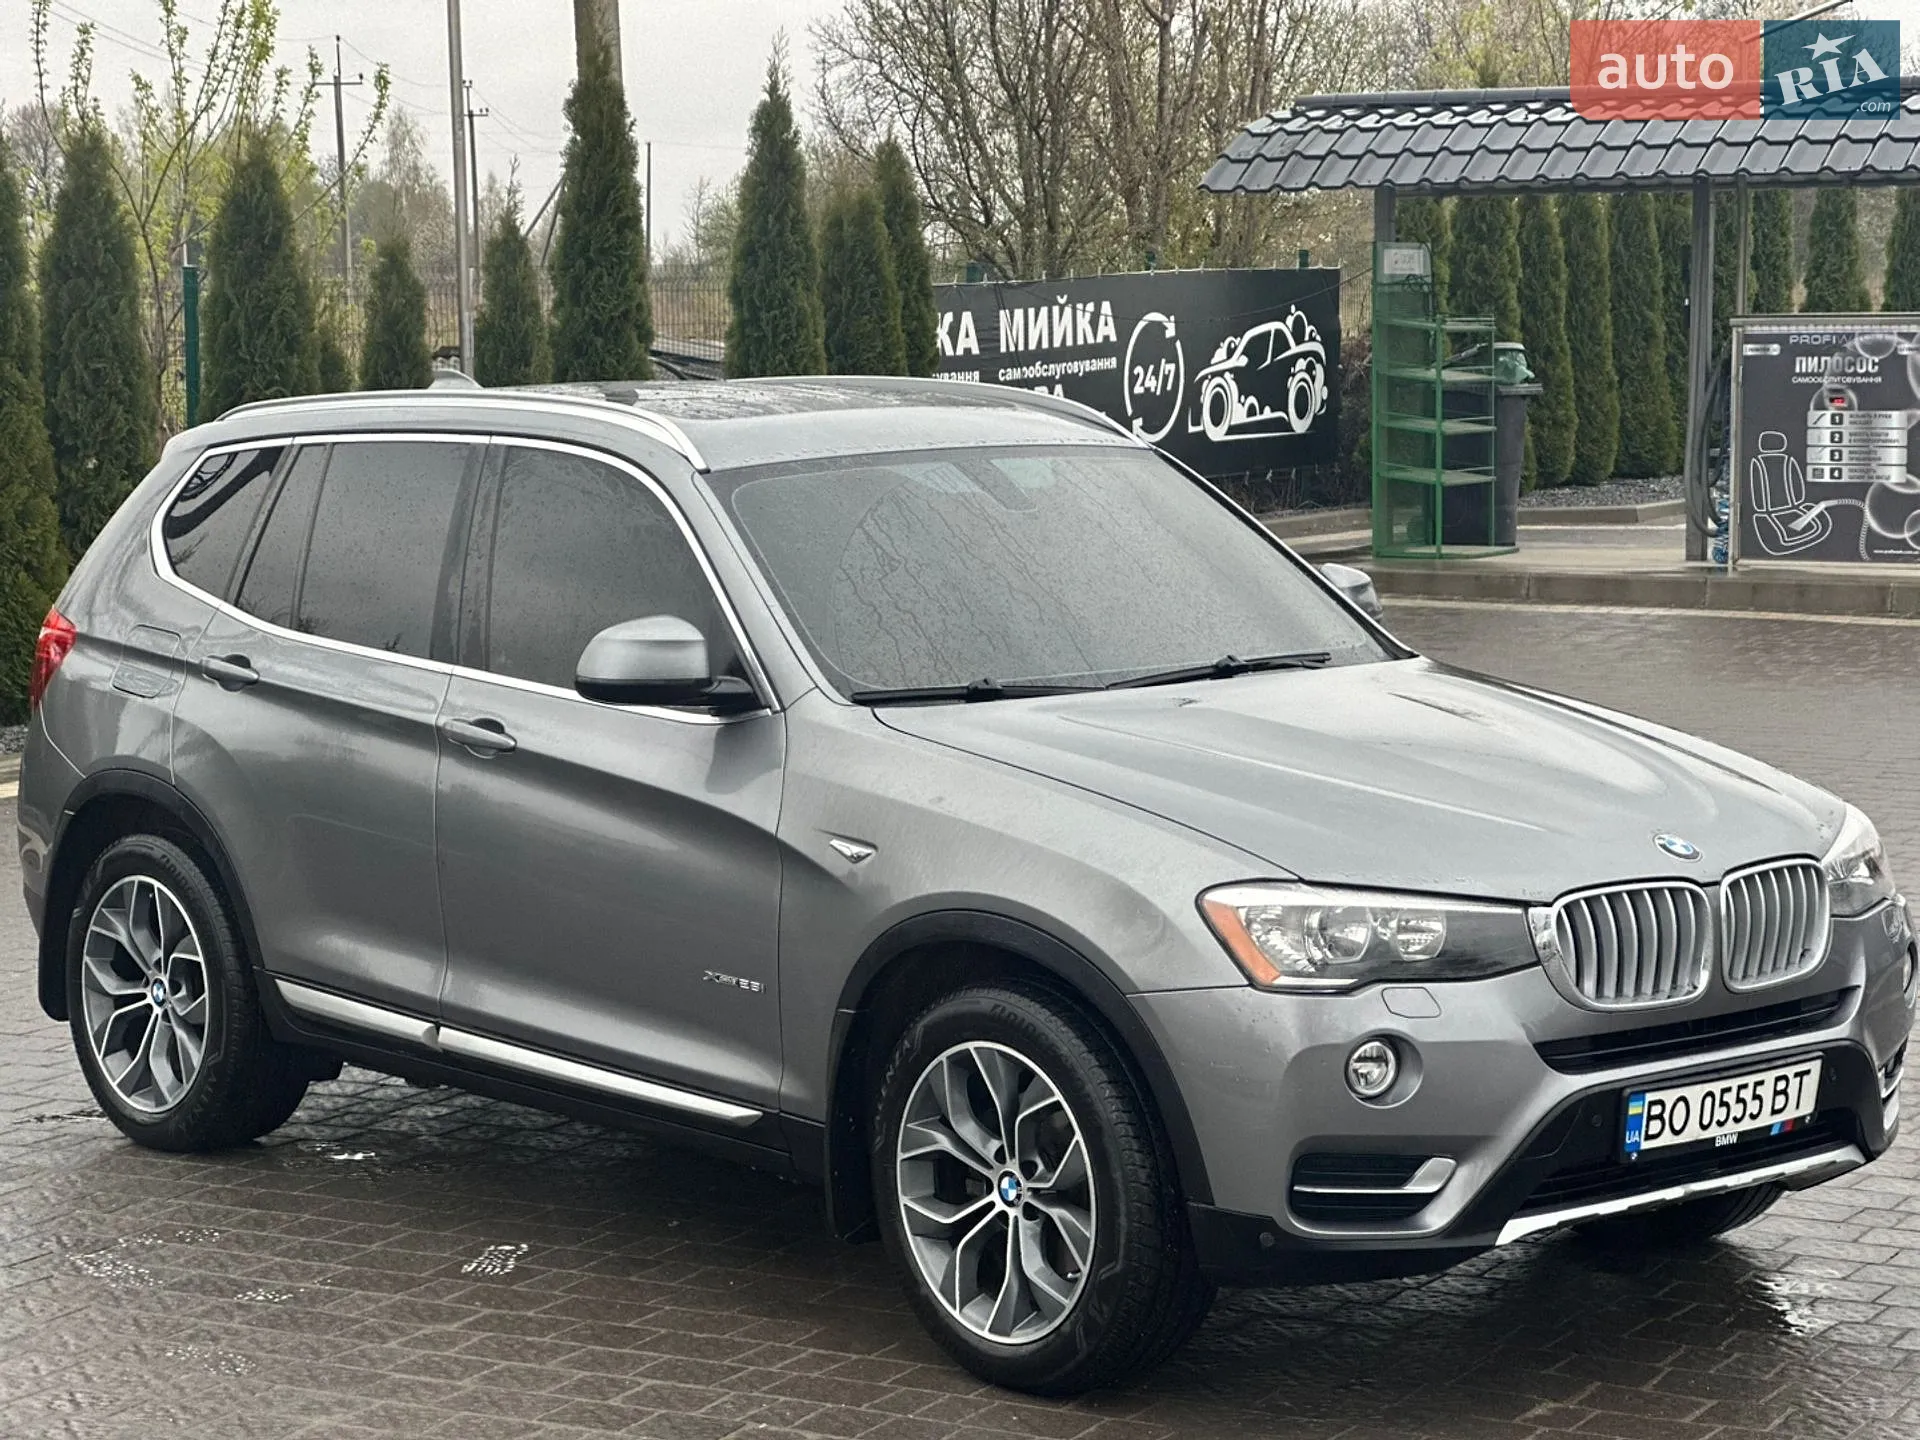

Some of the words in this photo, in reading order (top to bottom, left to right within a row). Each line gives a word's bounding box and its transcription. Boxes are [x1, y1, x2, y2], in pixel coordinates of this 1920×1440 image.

[999, 294, 1117, 353] МИЙКА
[998, 355, 1117, 382] самообслуговування
[1132, 358, 1176, 396] 24/7
[1794, 355, 1880, 374] ПИЛОСОС
[1644, 1094, 1691, 1142] BO
[1698, 1079, 1766, 1131] 0555
[1770, 1068, 1812, 1117] BT
[1625, 1130, 1640, 1144] UA
[1714, 1131, 1739, 1147] BMW
